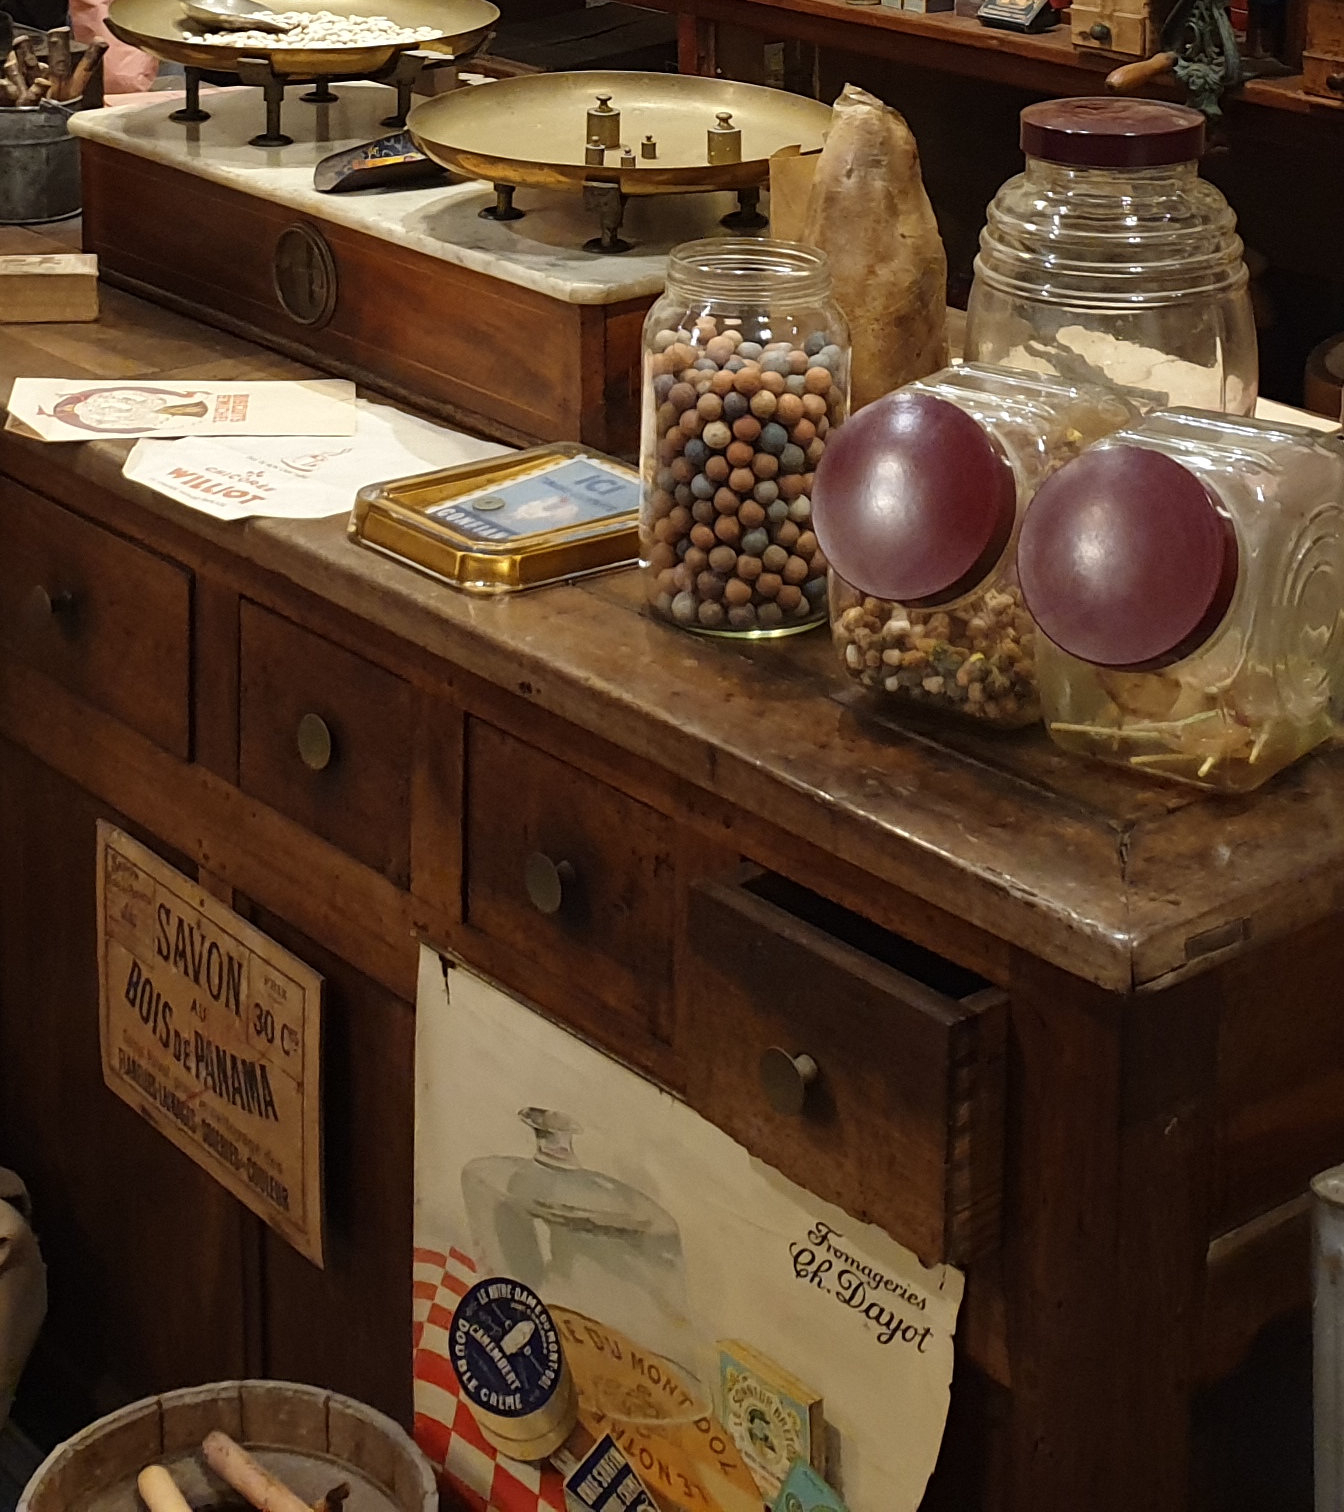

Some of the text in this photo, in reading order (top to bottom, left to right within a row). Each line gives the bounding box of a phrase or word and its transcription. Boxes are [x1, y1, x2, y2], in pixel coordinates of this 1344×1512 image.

[165, 466, 267, 506] WILLIOT
[155, 902, 243, 1018] SAVON
[190, 997, 207, 1023] AU
[253, 1002, 275, 1045] 30
[124, 958, 279, 1122] BOIS DE PANAMA
[630, 1352, 695, 1408] MONT
